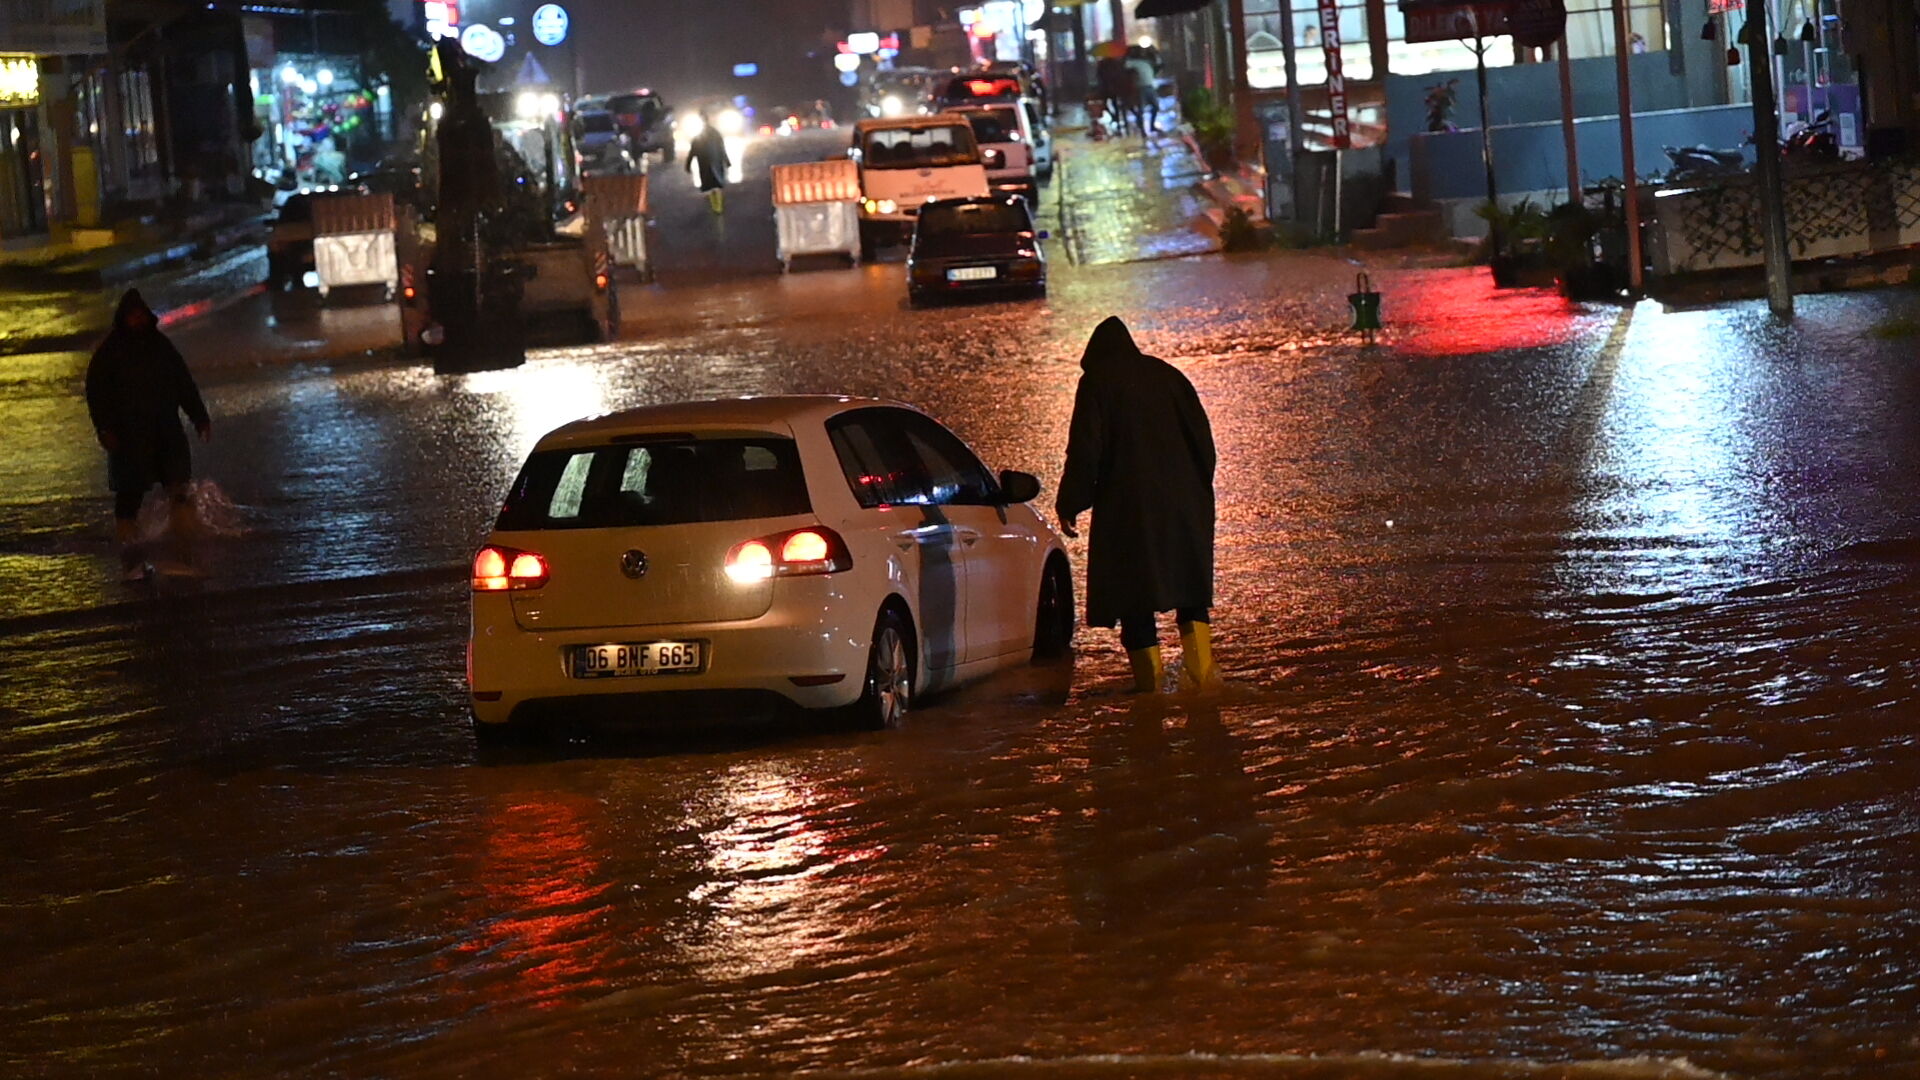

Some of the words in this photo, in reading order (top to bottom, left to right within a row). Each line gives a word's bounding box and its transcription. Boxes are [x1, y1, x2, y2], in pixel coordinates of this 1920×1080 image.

[587, 649, 608, 669] 06
[617, 646, 650, 668] BNF
[659, 645, 693, 666] 665
